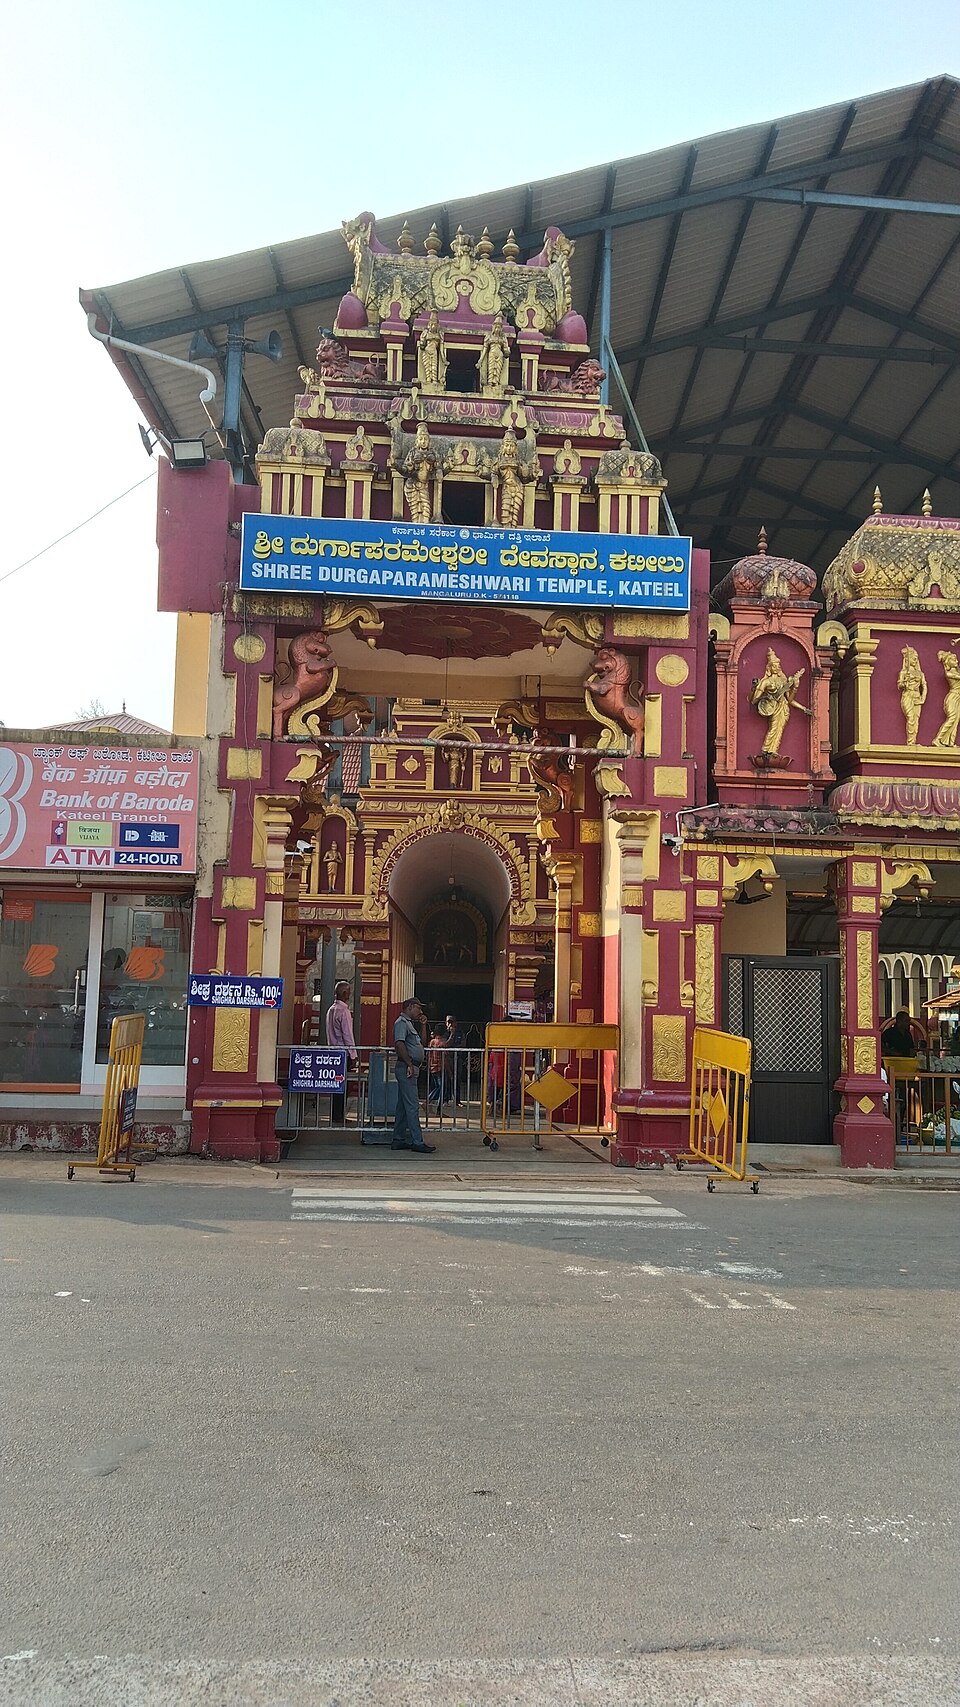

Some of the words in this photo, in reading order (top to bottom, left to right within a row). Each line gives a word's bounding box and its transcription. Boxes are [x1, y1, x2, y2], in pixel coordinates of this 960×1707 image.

[392, 526, 426, 536] ಕರ್ನಾಟಕ
[252, 530, 284, 559] ಶ್ರೀ
[290, 532, 488, 572] ದುರ್ಗಾಪರಮೇಶ್ವರೀ
[500, 545, 605, 577] ದೇವಸ್ಥಾನ,
[609, 548, 685, 573] ಕಟೀಲು
[251, 562, 312, 581] SHREE
[318, 566, 530, 593] DURGAPARAMESHWARI
[537, 577, 614, 598] TEMPLE,
[619, 580, 684, 597] KATEEL
[33, 747, 64, 764] ಬ್ಯಾಂಕ್
[137, 750, 167, 762] ಕಟೀಲು
[170, 751, 193, 763] ಶಾಖೆ
[42, 762, 77, 783] बैंक
[134, 765, 191, 789] बड़ौदा
[40, 790, 95, 808] Bank
[97, 791, 118, 809] of
[120, 792, 194, 811] Baroda
[56, 810, 105, 820] Kateel
[111, 811, 168, 822] Branch
[50, 848, 111, 866] ATM
[119, 853, 178, 865] 24-HOUR
[214, 981, 242, 997] ದರ್ಶನ
[245, 985, 258, 997] Rs.
[261, 985, 281, 998] 100/-
[211, 996, 235, 1004] SHIGHRA
[236, 996, 265, 1005] DARSHANA
[316, 1054, 341, 1066] ದರ್ಶನ
[318, 1069, 336, 1079] 100
[293, 1079, 314, 1088] SHIGHRA
[315, 1080, 340, 1088] DARSHANA
